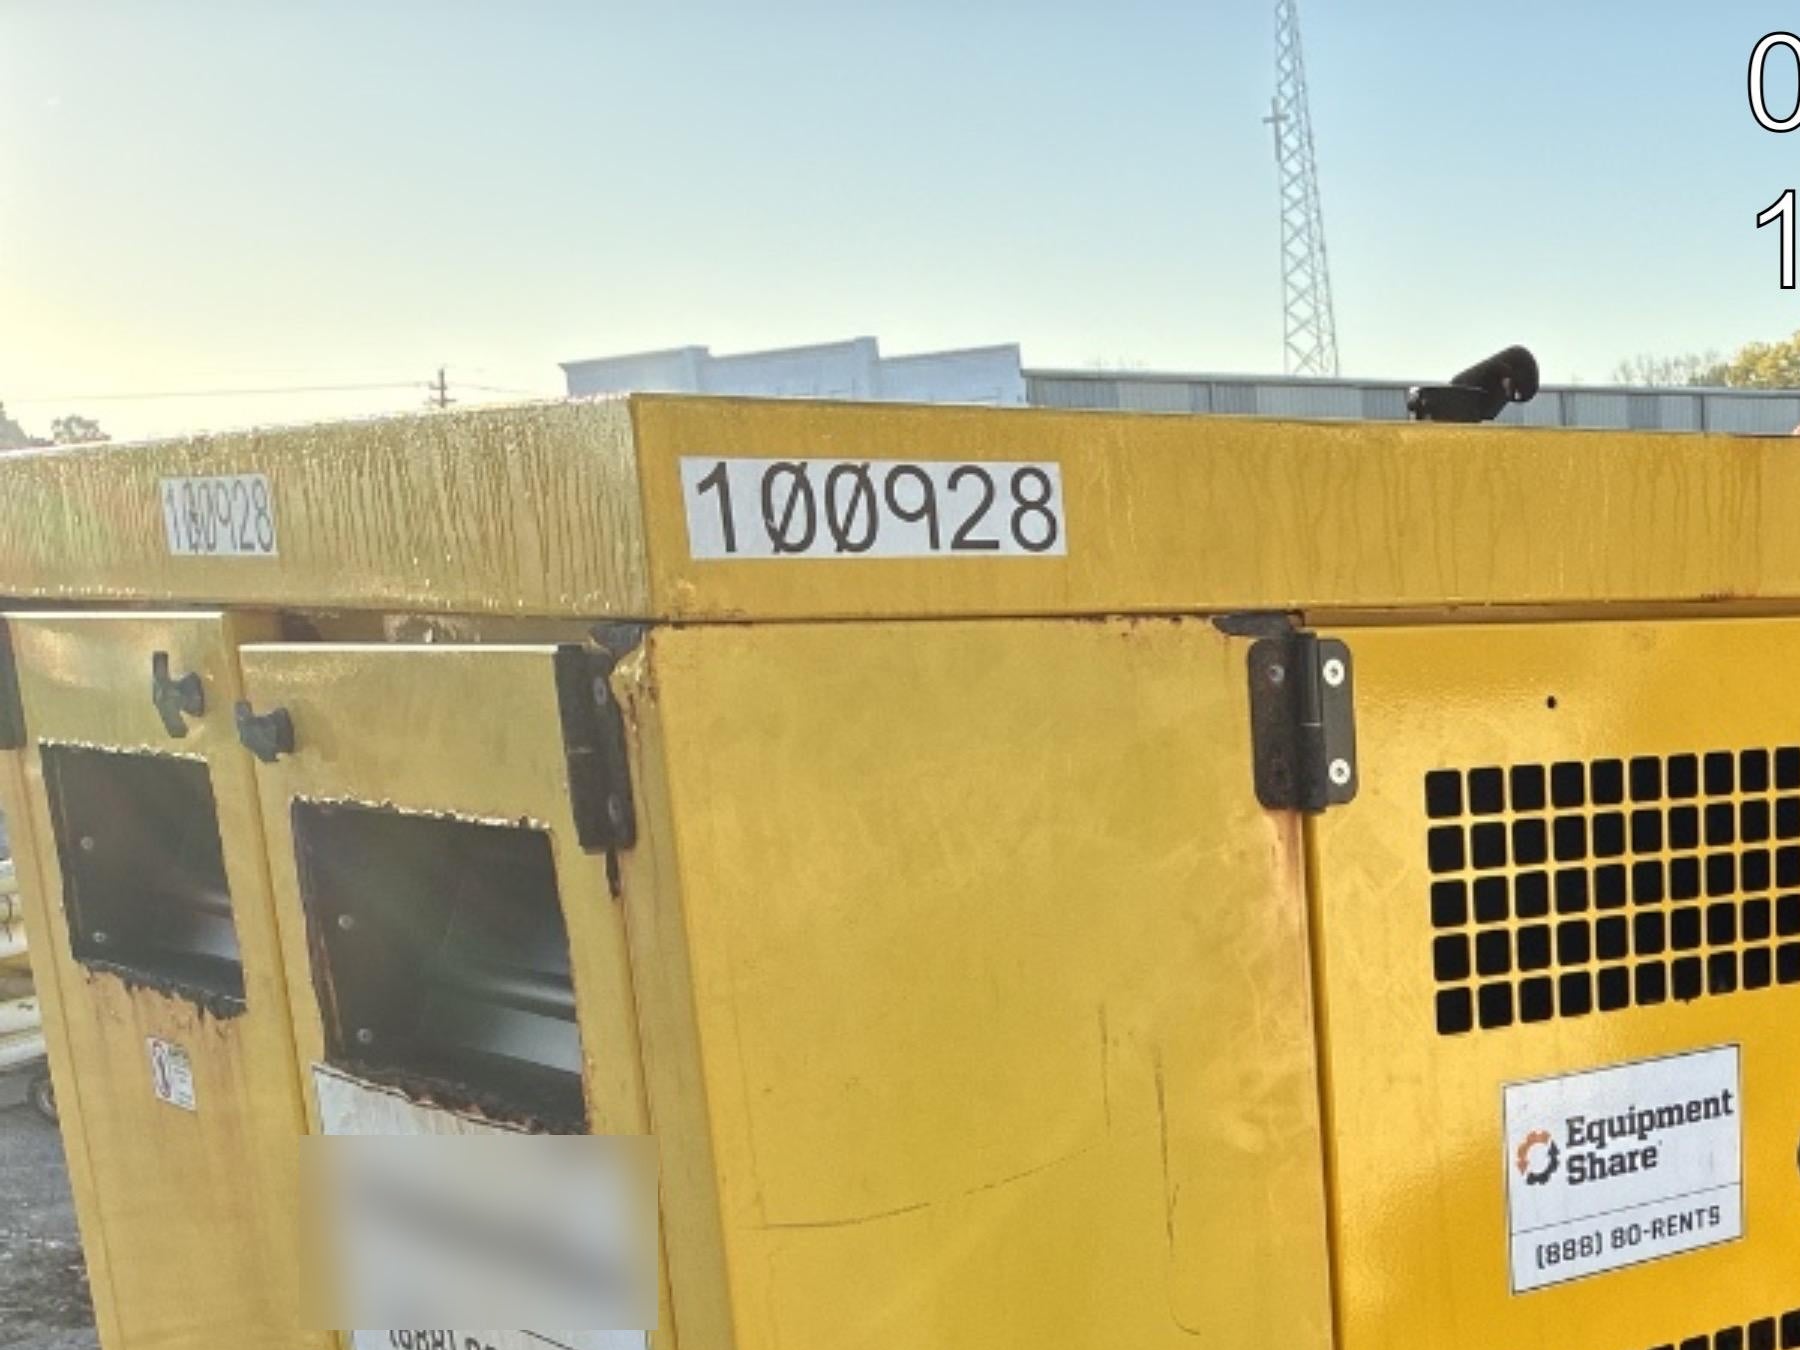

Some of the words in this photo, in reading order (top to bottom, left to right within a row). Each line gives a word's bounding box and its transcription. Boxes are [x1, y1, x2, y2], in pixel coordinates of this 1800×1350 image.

[694, 459, 1059, 555] 100928
[1565, 1088, 1734, 1149] Equipment
[1566, 1143, 1659, 1186] Share
[1536, 1231, 1602, 1270] (888)
[1611, 1204, 1721, 1251] 80-RENTS
